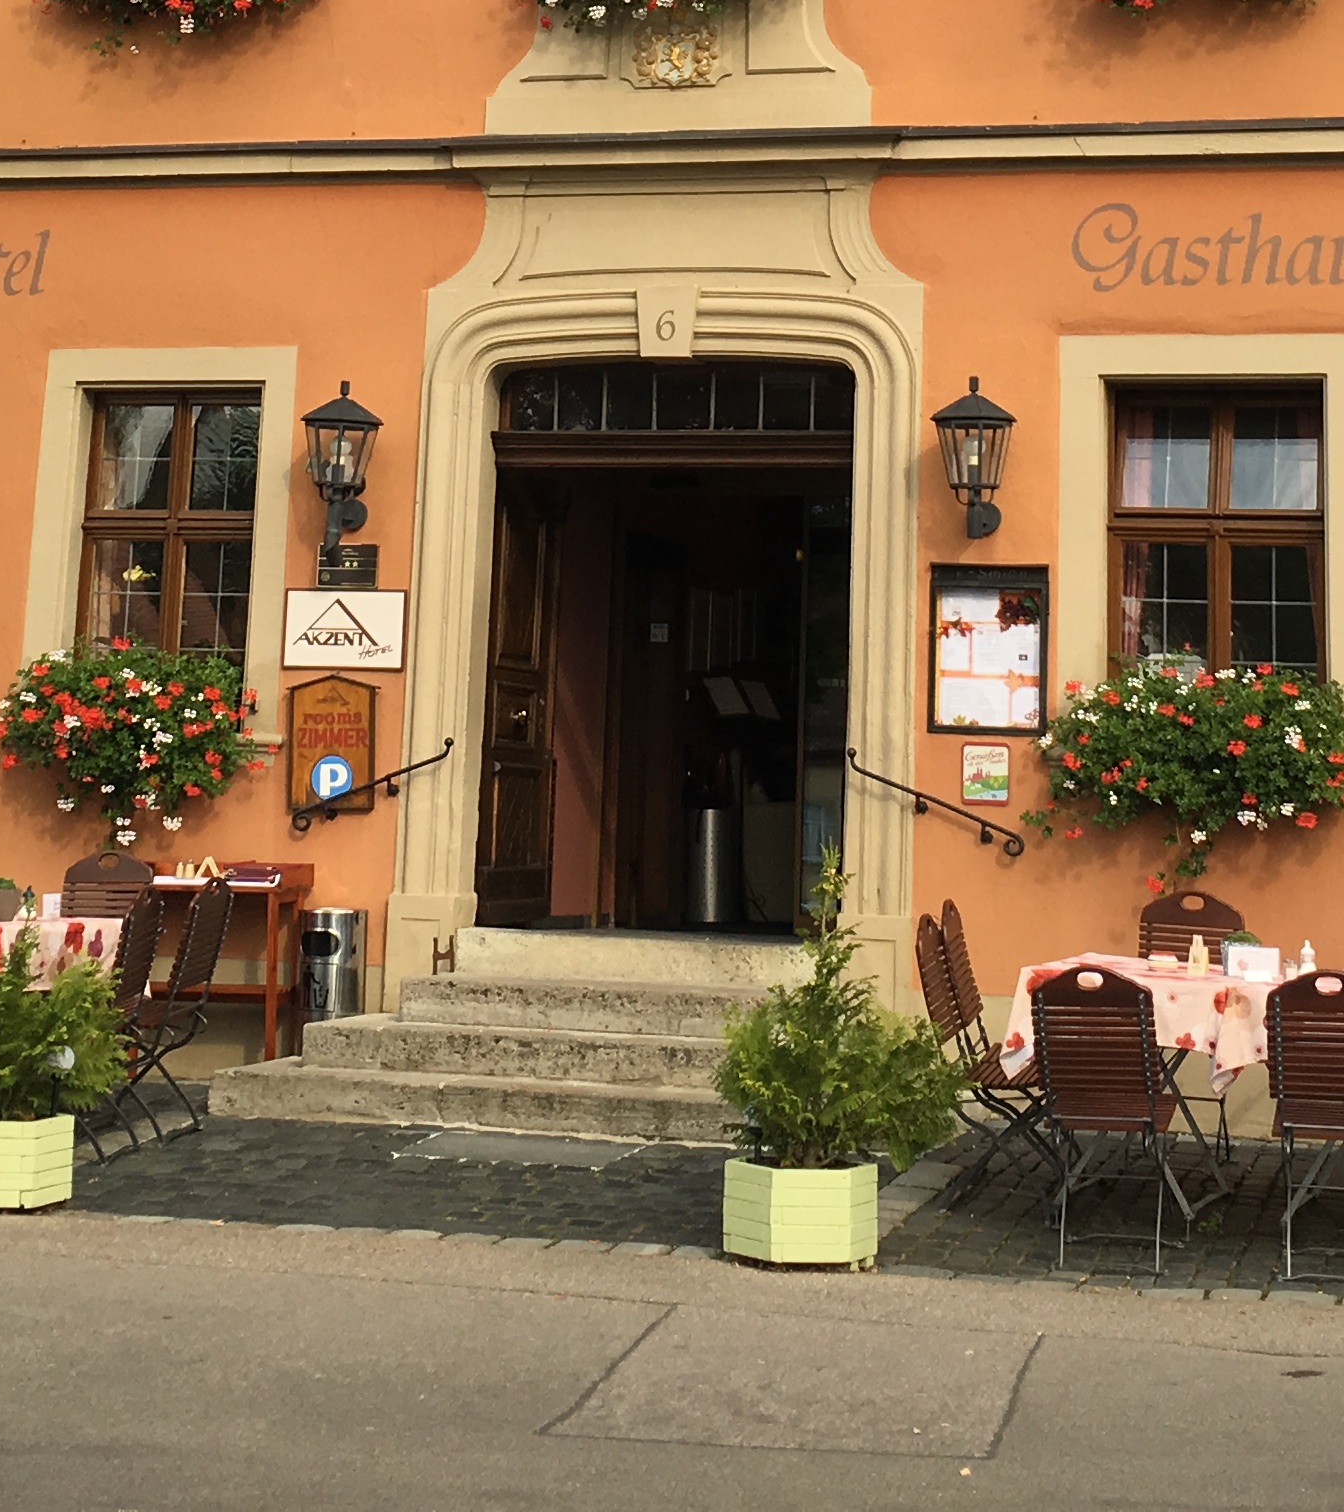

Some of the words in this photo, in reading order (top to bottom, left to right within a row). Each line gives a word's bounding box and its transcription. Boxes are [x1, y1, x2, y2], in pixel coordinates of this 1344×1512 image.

[655, 309, 676, 342] 6
[293, 631, 365, 646] AKZENT
[303, 711, 363, 726] rooms
[297, 727, 369, 749] ZIMMER
